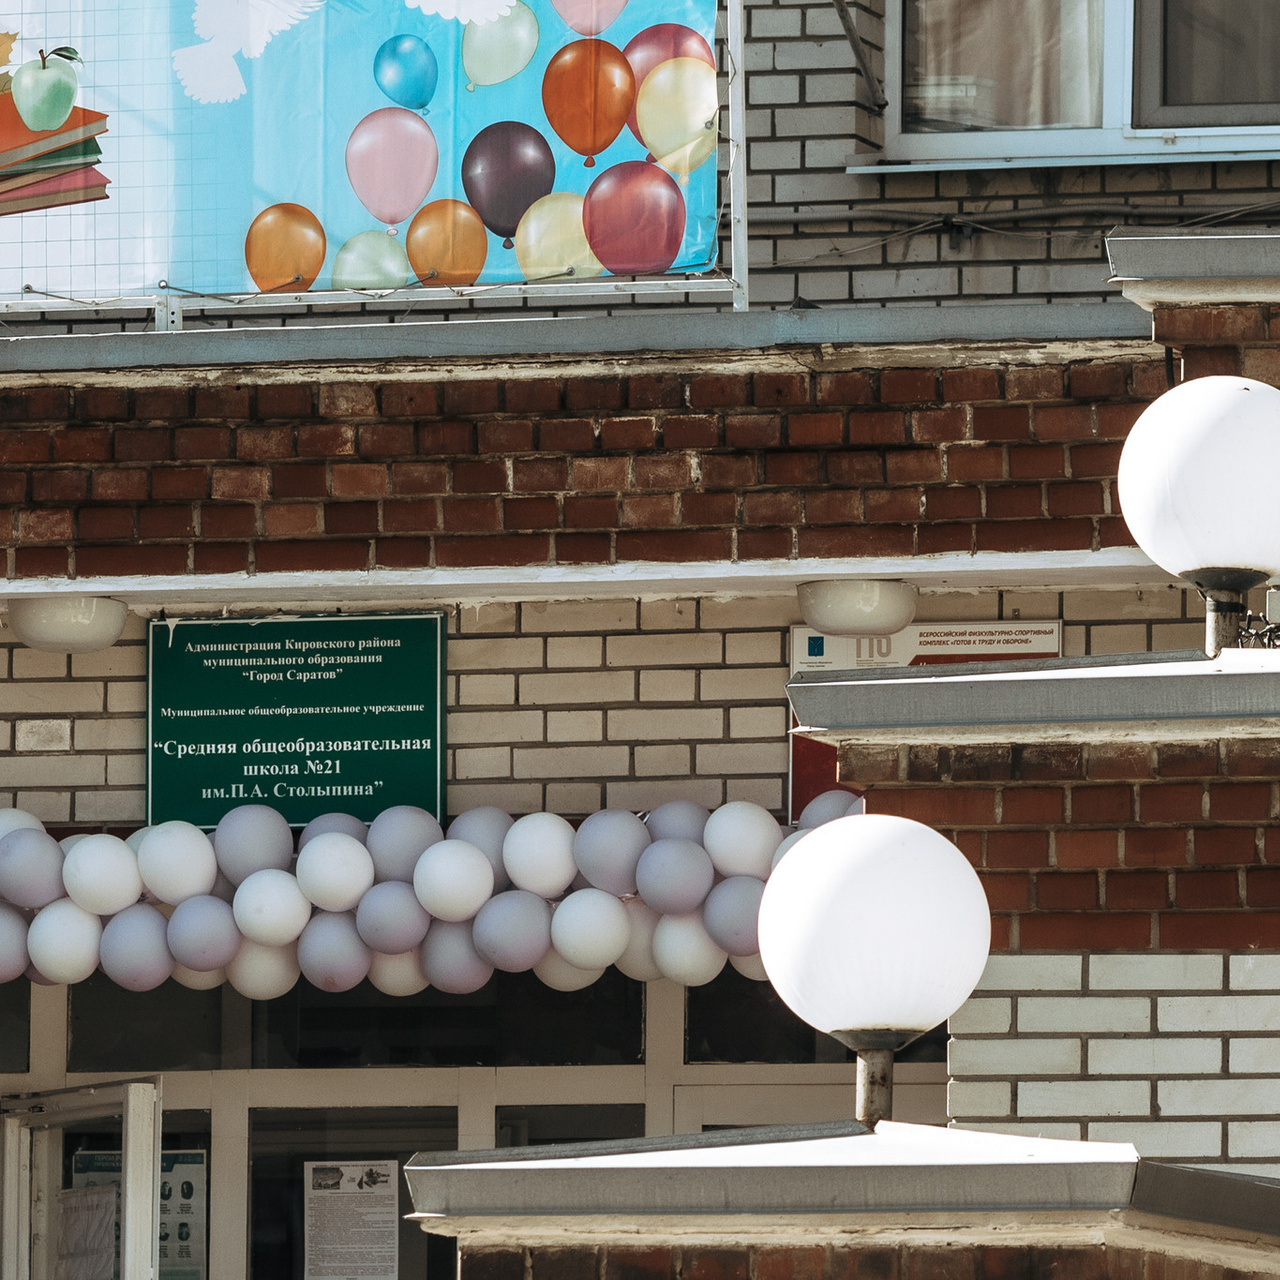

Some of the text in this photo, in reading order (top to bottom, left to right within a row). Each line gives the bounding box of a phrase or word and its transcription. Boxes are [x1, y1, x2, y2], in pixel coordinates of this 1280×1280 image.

[918, 628, 1055, 638] ВСЕРОССИЙСКИЙ ФИЗКУЛЬТУРНО-СПОРТИВНЫЙ
[184, 637, 402, 654] Администрация Кировского района
[203, 652, 383, 669] муниципального образования
[160, 702, 425, 719] Муниципальное общеобразовательное учреждение
[242, 737, 432, 756] общеобразовательная
[243, 759, 342, 776] школа №21
